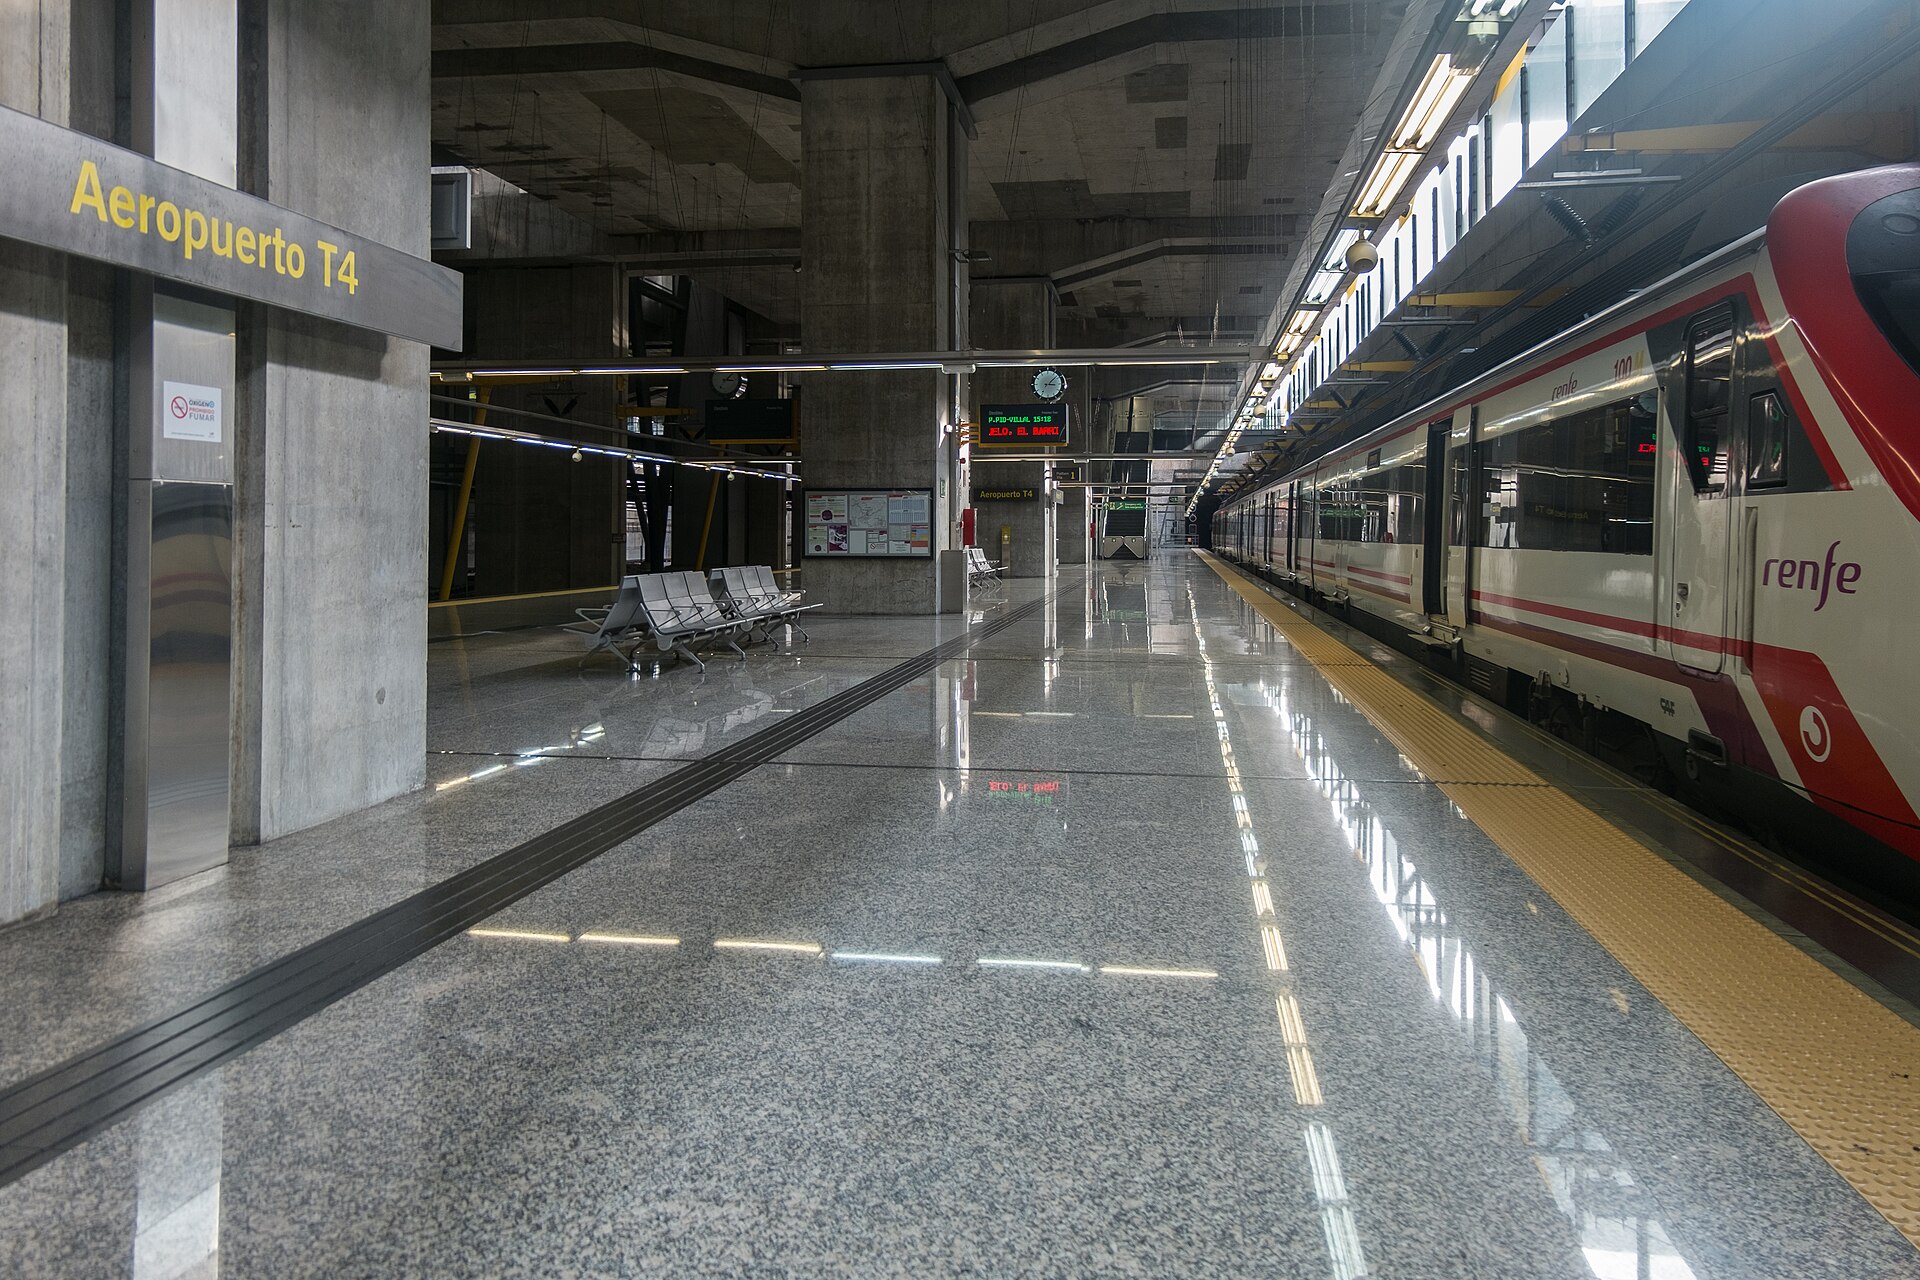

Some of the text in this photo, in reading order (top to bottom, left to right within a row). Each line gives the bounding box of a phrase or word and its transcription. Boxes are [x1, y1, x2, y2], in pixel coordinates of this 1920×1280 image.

[70, 160, 359, 295] Aeropuerto T4
[1552, 371, 1578, 401] renfe
[189, 413, 215, 422] FUMAR
[1017, 427, 1029, 436] EL
[1070, 471, 1076, 480] 1
[980, 490, 1033, 499] Aeropuerto T4
[1762, 540, 1862, 612] renfe
